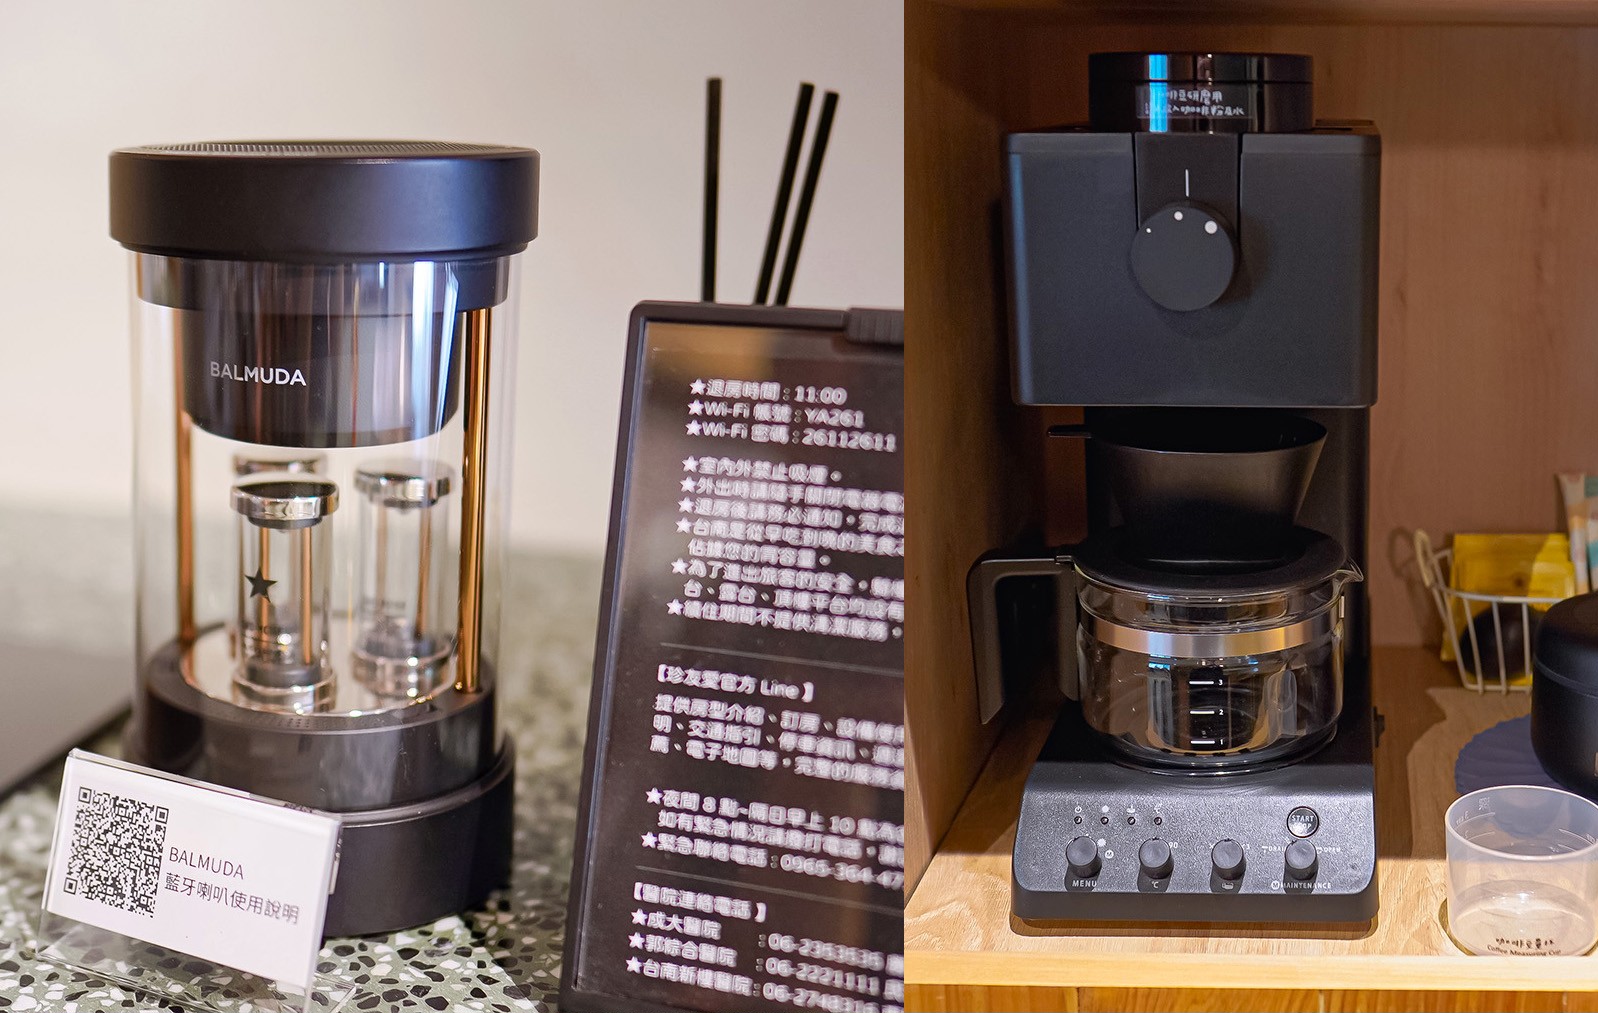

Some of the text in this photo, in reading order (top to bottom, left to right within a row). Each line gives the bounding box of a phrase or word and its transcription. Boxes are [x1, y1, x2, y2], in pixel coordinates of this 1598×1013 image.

[210, 361, 307, 386] BALMUDA
[703, 401, 750, 418] Wi-Fi
[701, 421, 748, 439] Wi-Fi
[702, 797, 717, 814] 8
[829, 816, 856, 835] 10
[169, 847, 245, 880] BALMUDA
[1072, 880, 1097, 888] MENU
[164, 872, 300, 925] 藍牙喇叭使用說明
